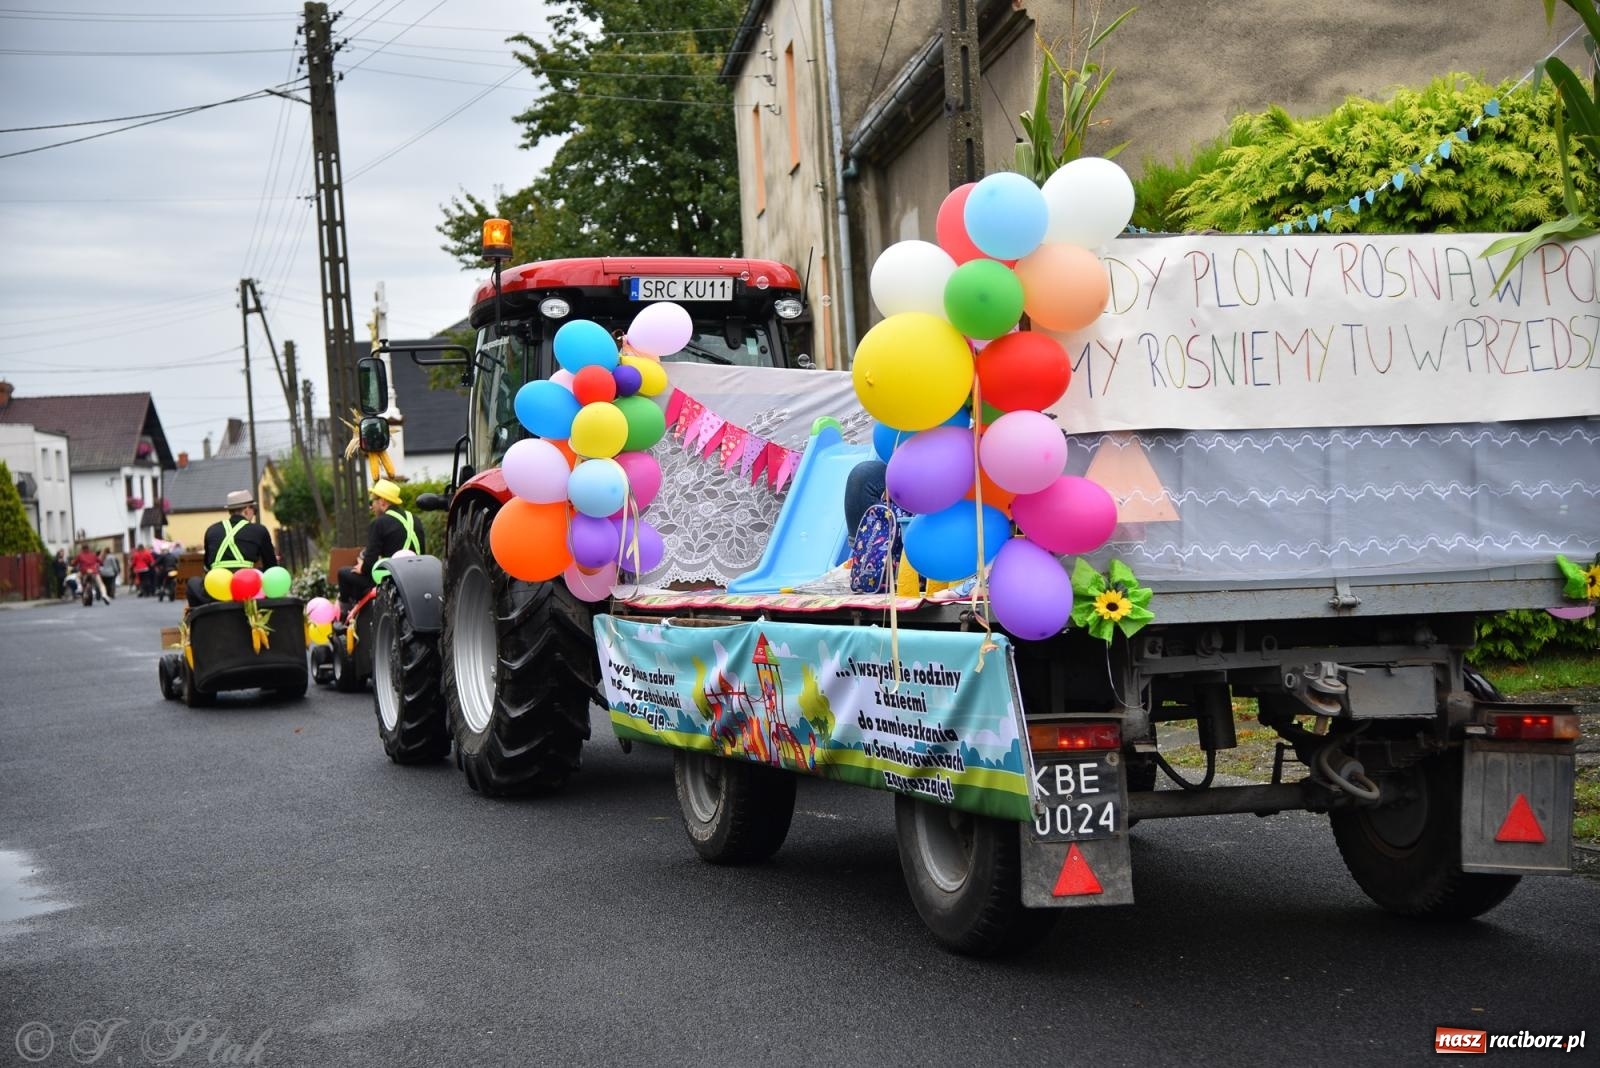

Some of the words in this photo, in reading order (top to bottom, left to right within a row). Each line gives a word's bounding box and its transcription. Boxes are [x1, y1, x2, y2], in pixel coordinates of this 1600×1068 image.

[643, 280, 677, 298] SRC
[684, 280, 726, 299] KU11
[1103, 257, 1166, 315] DY
[1184, 247, 1319, 308] PLONY
[1334, 242, 1480, 308] ROSNĄ
[1486, 254, 1525, 307] W
[1138, 319, 1334, 390] ROŚNIEMY
[1342, 323, 1393, 375] TU
[1405, 323, 1448, 372] W
[648, 667, 675, 686] zabaw
[913, 663, 961, 693] rodziny
[875, 690, 882, 706] z
[883, 687, 928, 713] dziećmi
[857, 710, 874, 731] do
[875, 715, 959, 743] zamieszkania
[863, 741, 872, 757] w
[873, 739, 964, 772] Samborowicach
[883, 771, 954, 802] zapraszają!
[1034, 763, 1099, 797] KBE
